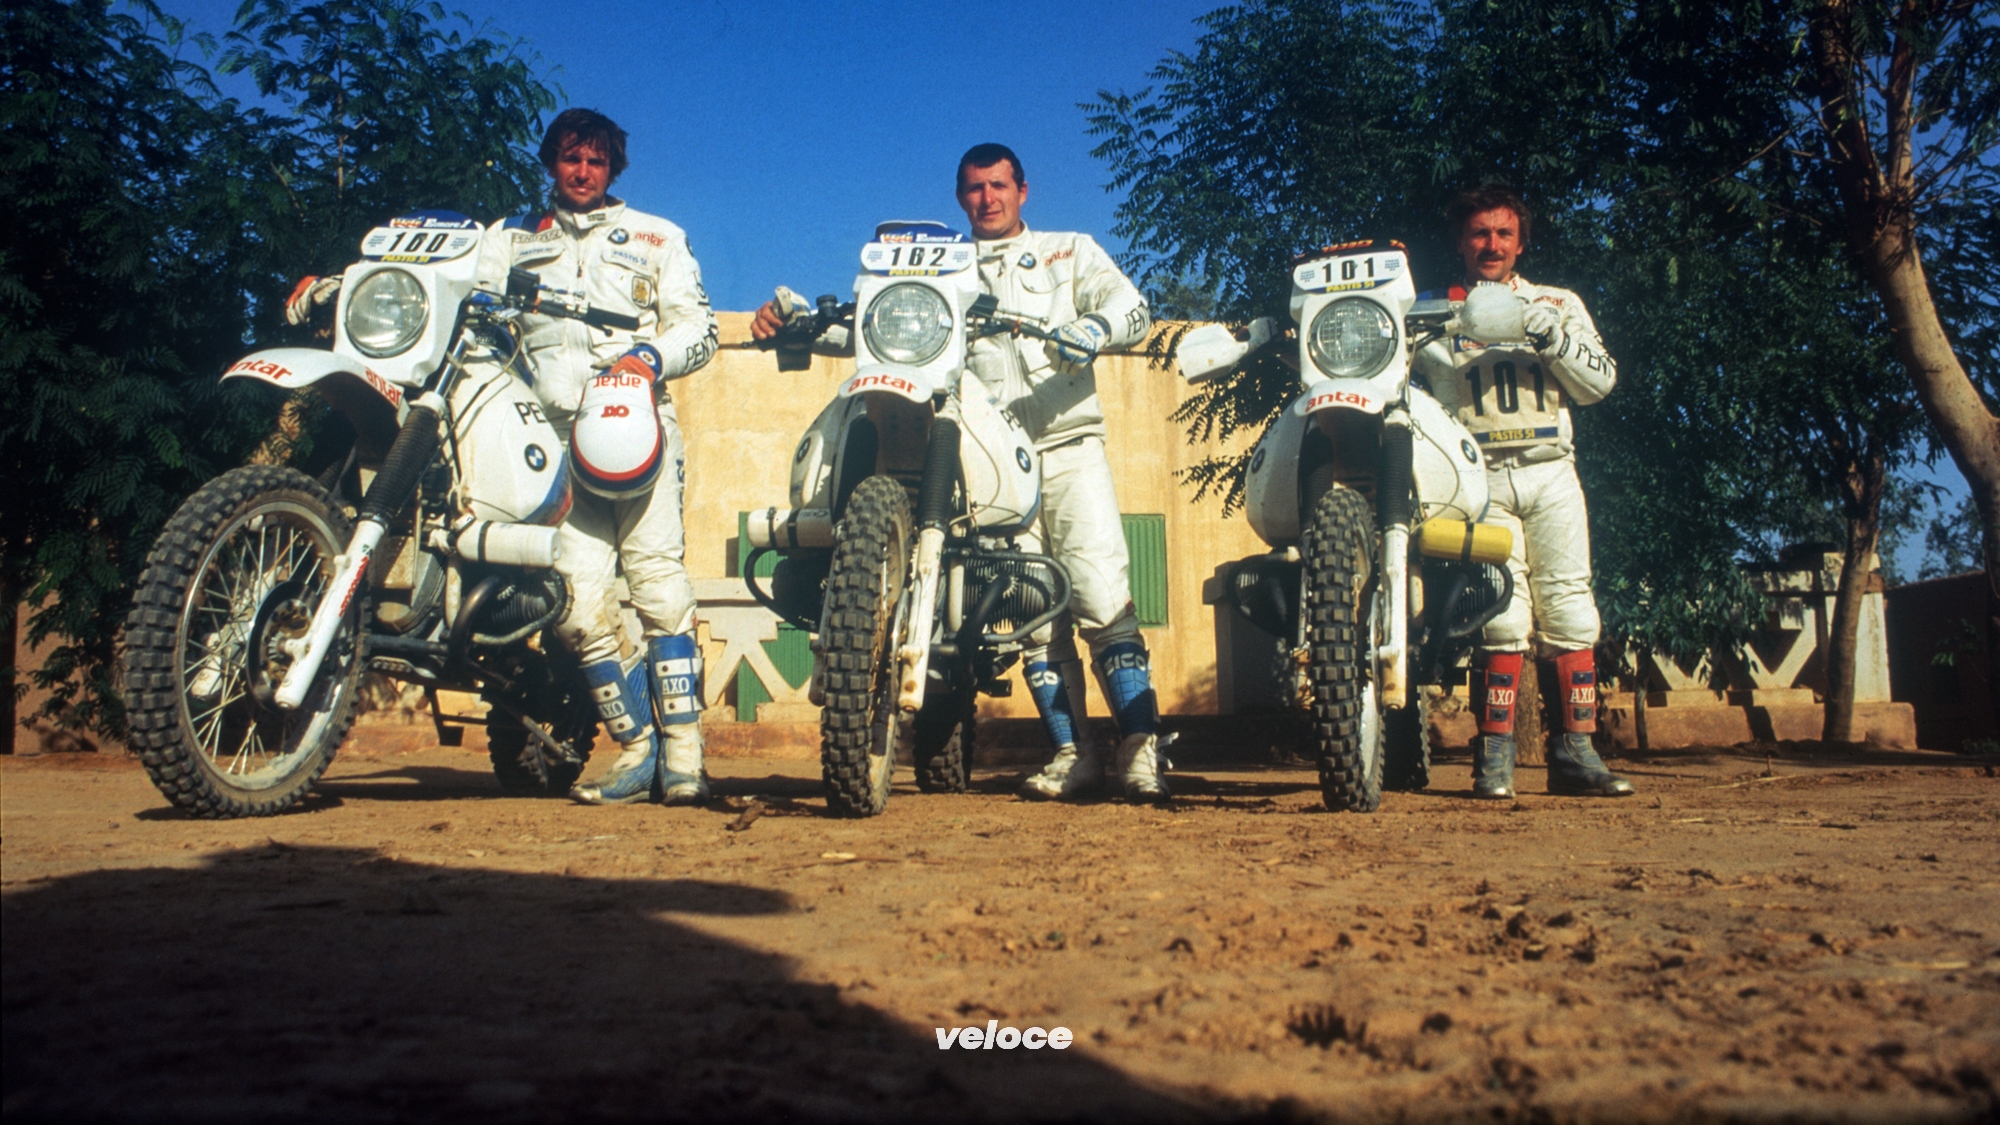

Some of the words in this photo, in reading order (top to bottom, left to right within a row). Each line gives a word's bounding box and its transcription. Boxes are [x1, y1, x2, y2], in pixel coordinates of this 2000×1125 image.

[388, 231, 450, 253] 160
[634, 232, 666, 247] antar
[891, 247, 947, 267] 162
[1045, 249, 1074, 267] antar
[1322, 257, 1375, 284] 101
[364, 367, 401, 403] antar
[593, 374, 642, 388] antar
[847, 374, 918, 394] antar
[1465, 360, 1545, 416] 101
[1305, 391, 1371, 413] antar
[1489, 430, 1523, 442] PASTIS
[662, 677, 690, 696] AXO
[1569, 686, 1596, 704] AXO
[1486, 688, 1514, 705] AXO
